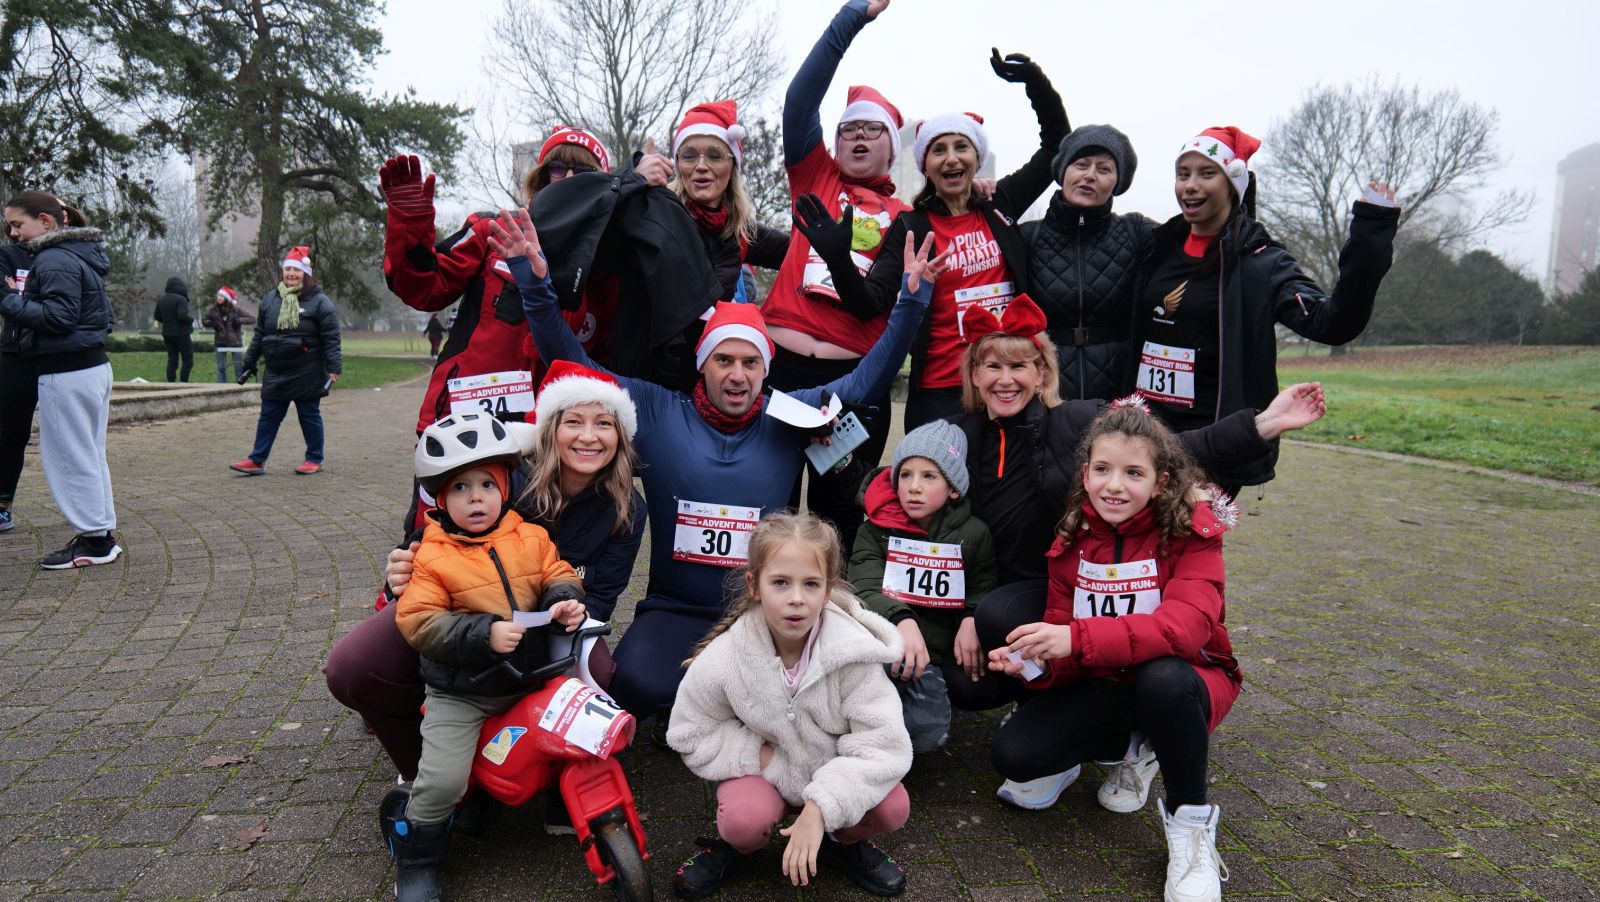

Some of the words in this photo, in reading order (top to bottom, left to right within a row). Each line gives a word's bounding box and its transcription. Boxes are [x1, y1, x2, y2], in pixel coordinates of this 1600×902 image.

[567, 134, 589, 147] OH
[955, 230, 988, 253] POLU
[945, 239, 1002, 272] MARATO
[1149, 368, 1175, 394] 131
[479, 396, 509, 417] 34
[701, 529, 732, 556] 30
[905, 567, 950, 597] 146
[1087, 593, 1136, 618] 147
